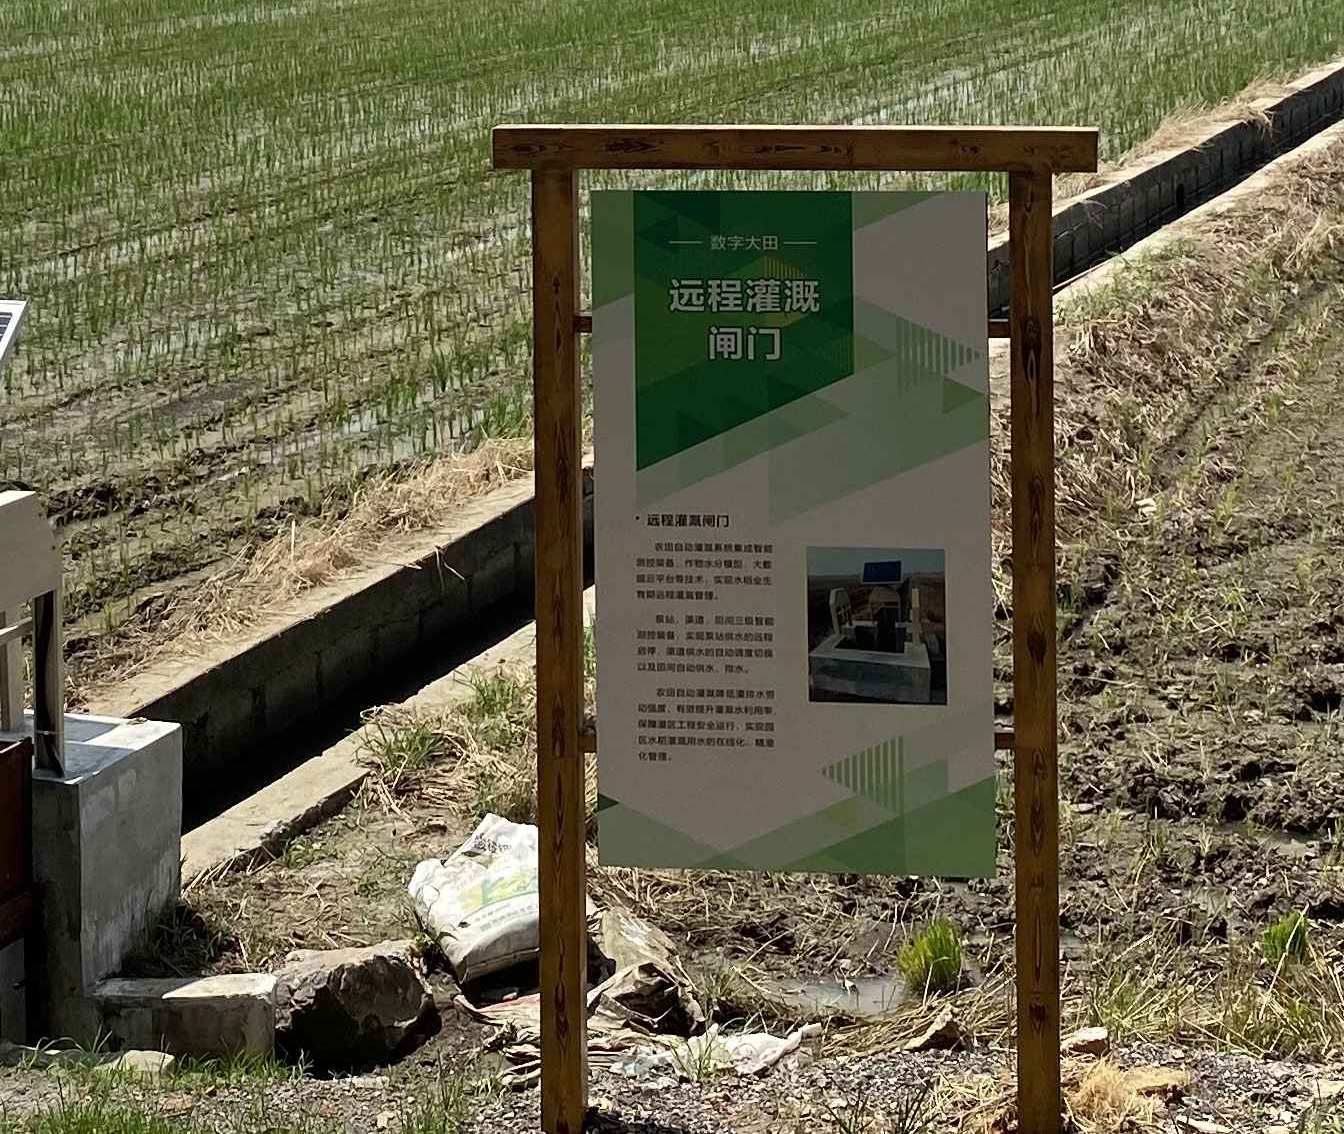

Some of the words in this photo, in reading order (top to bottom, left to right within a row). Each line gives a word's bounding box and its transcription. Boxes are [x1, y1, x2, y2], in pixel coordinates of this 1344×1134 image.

[709, 234, 779, 252] 数字大田
[669, 278, 821, 314] 远程灌溉
[709, 326, 782, 362] 闸门
